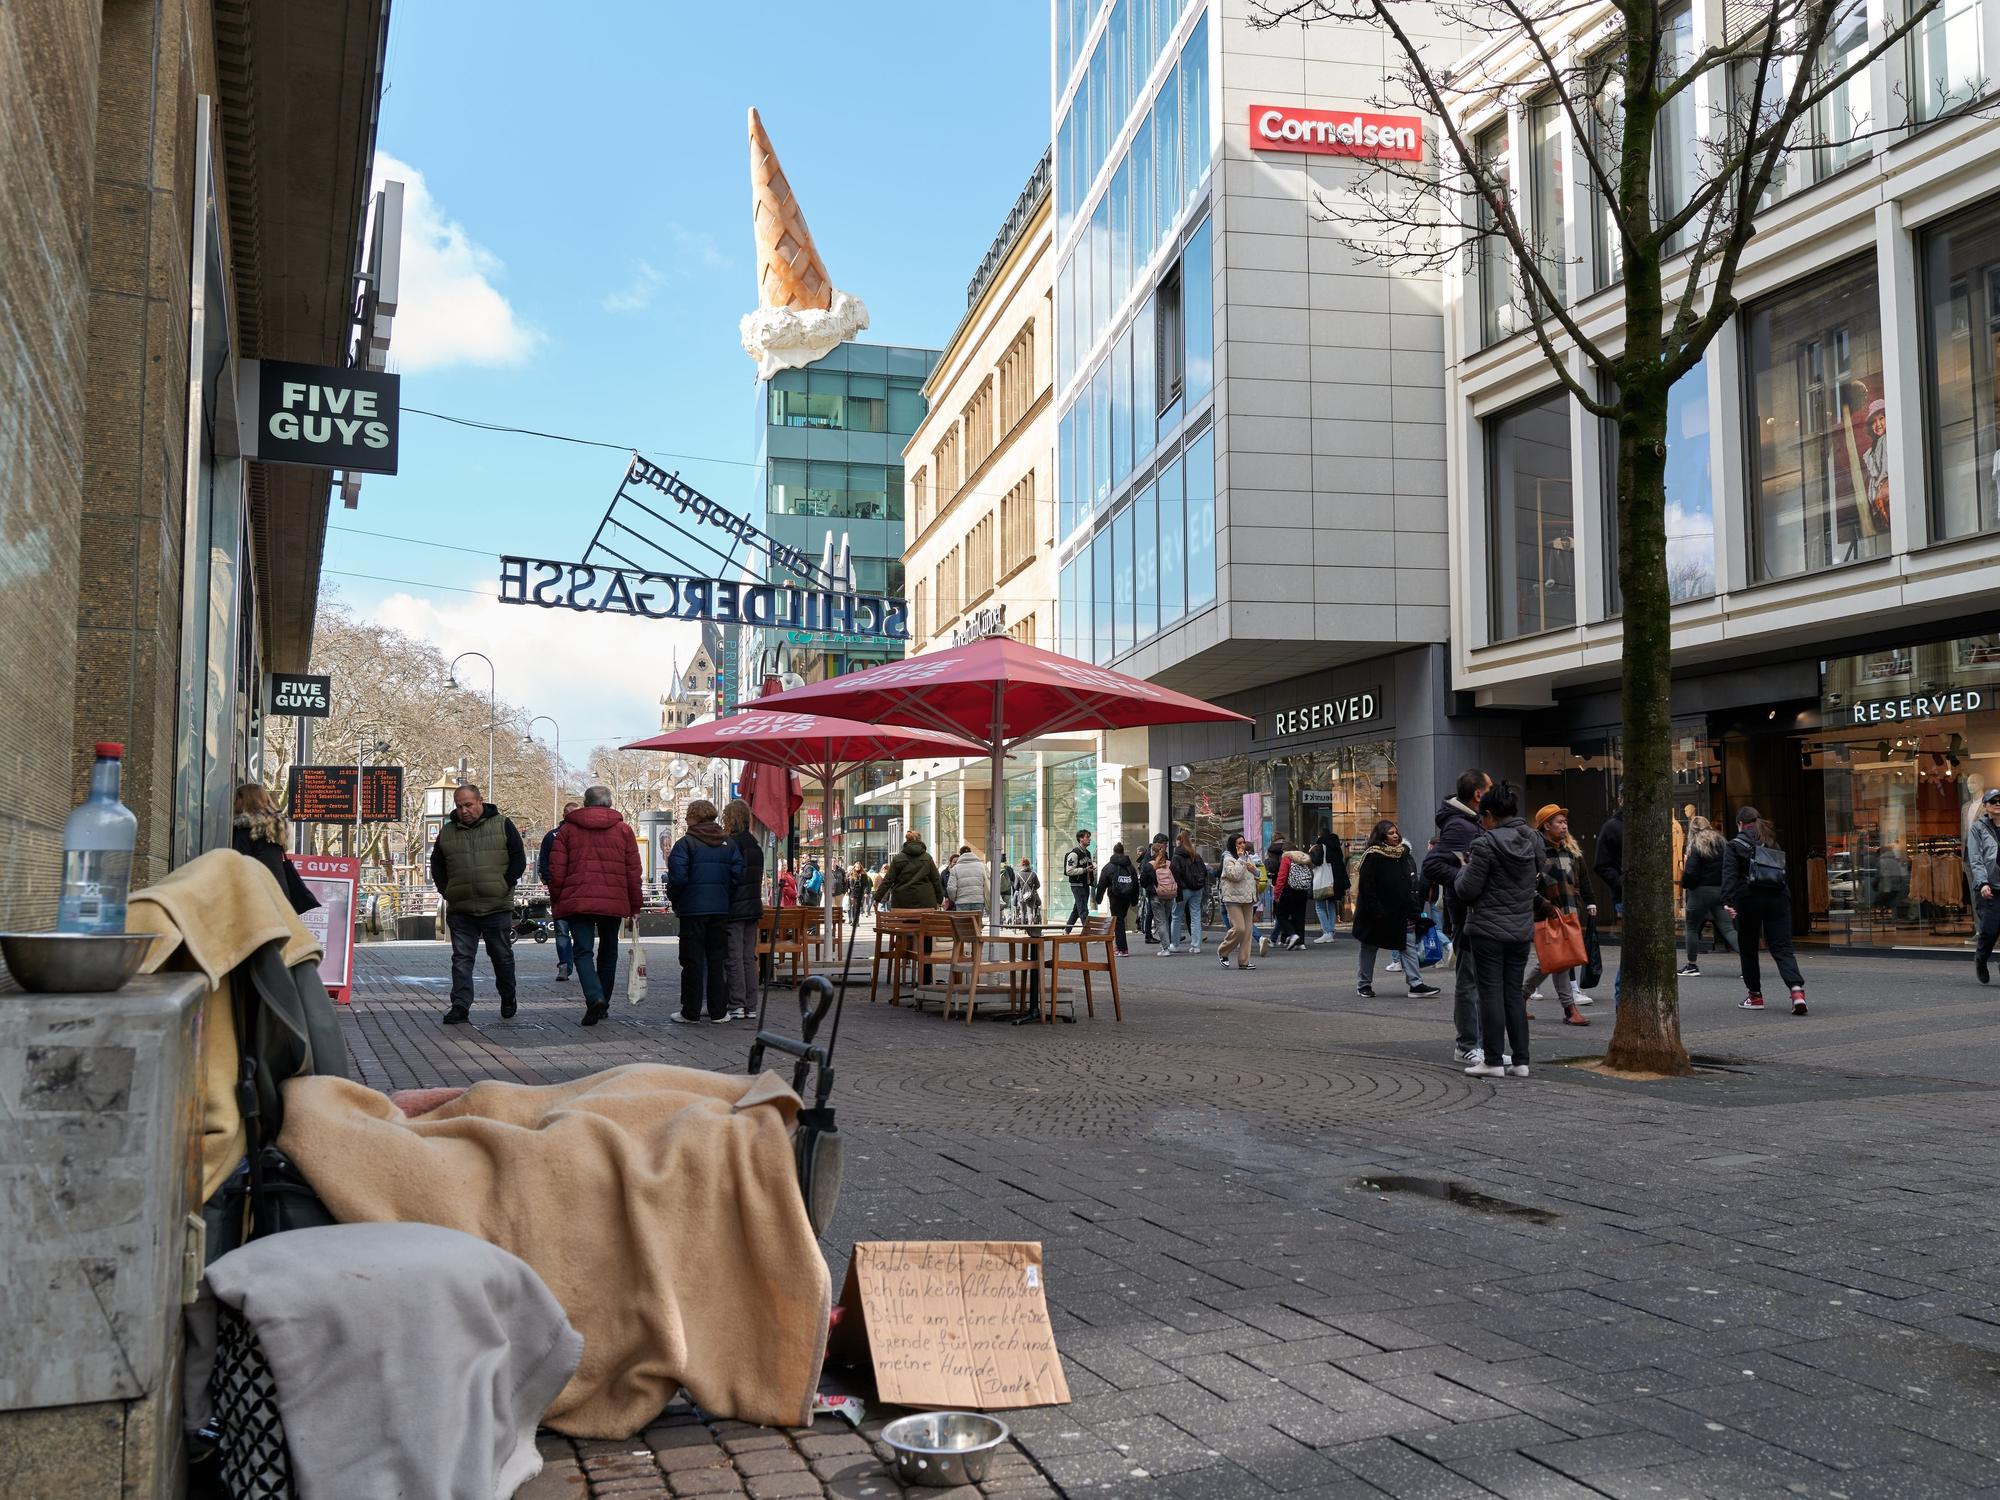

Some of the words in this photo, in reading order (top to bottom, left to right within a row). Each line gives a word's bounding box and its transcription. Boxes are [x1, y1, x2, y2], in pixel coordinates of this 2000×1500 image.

[1259, 110, 1416, 150] Cornelsen
[282, 381, 378, 418] FIVE
[268, 411, 390, 449] GUYS
[281, 681, 321, 695] FIVE
[275, 694, 326, 709] GUYS
[1854, 691, 1981, 723] RESERVED
[737, 713, 818, 727] FIVE
[1276, 694, 1374, 735] RESERVED
[715, 722, 816, 736] GUYS
[307, 861, 349, 873] GUYS
[862, 1275, 893, 1297] Ich
[899, 1277, 919, 1298] bin
[924, 1278, 960, 1298] kein
[866, 1301, 914, 1326] Bitte
[922, 1313, 949, 1326] um
[957, 1309, 996, 1326] eine
[1001, 1303, 1049, 1326] kleine
[873, 1330, 930, 1352] Spende
[938, 1330, 969, 1353] für
[974, 1328, 1019, 1351] mich
[879, 1353, 933, 1371] meine
